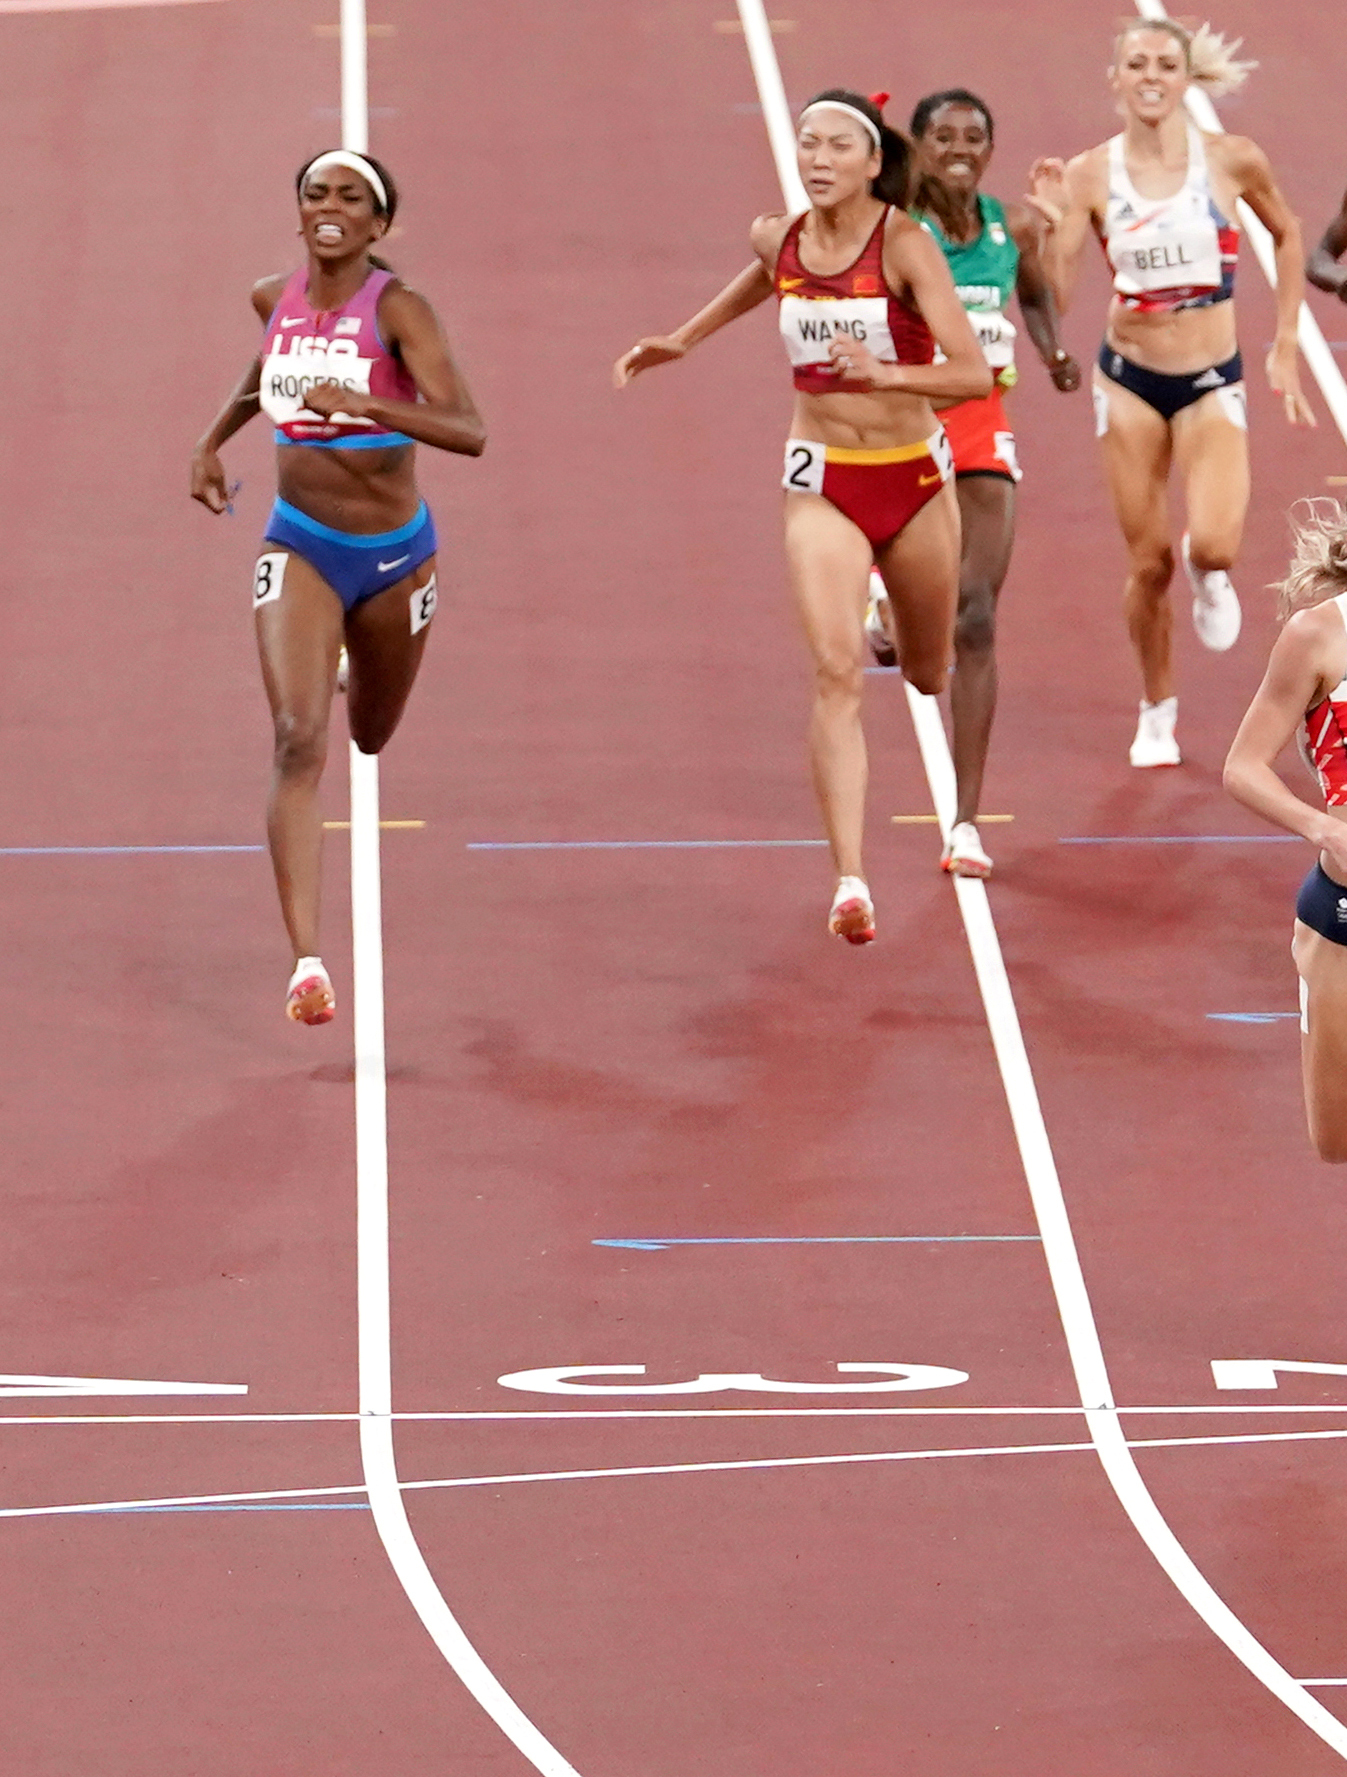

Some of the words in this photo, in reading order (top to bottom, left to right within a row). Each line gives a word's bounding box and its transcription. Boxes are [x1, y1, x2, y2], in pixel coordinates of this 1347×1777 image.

[1135, 244, 1193, 270] BELL
[798, 319, 867, 342] WANG
[789, 446, 813, 488] 2
